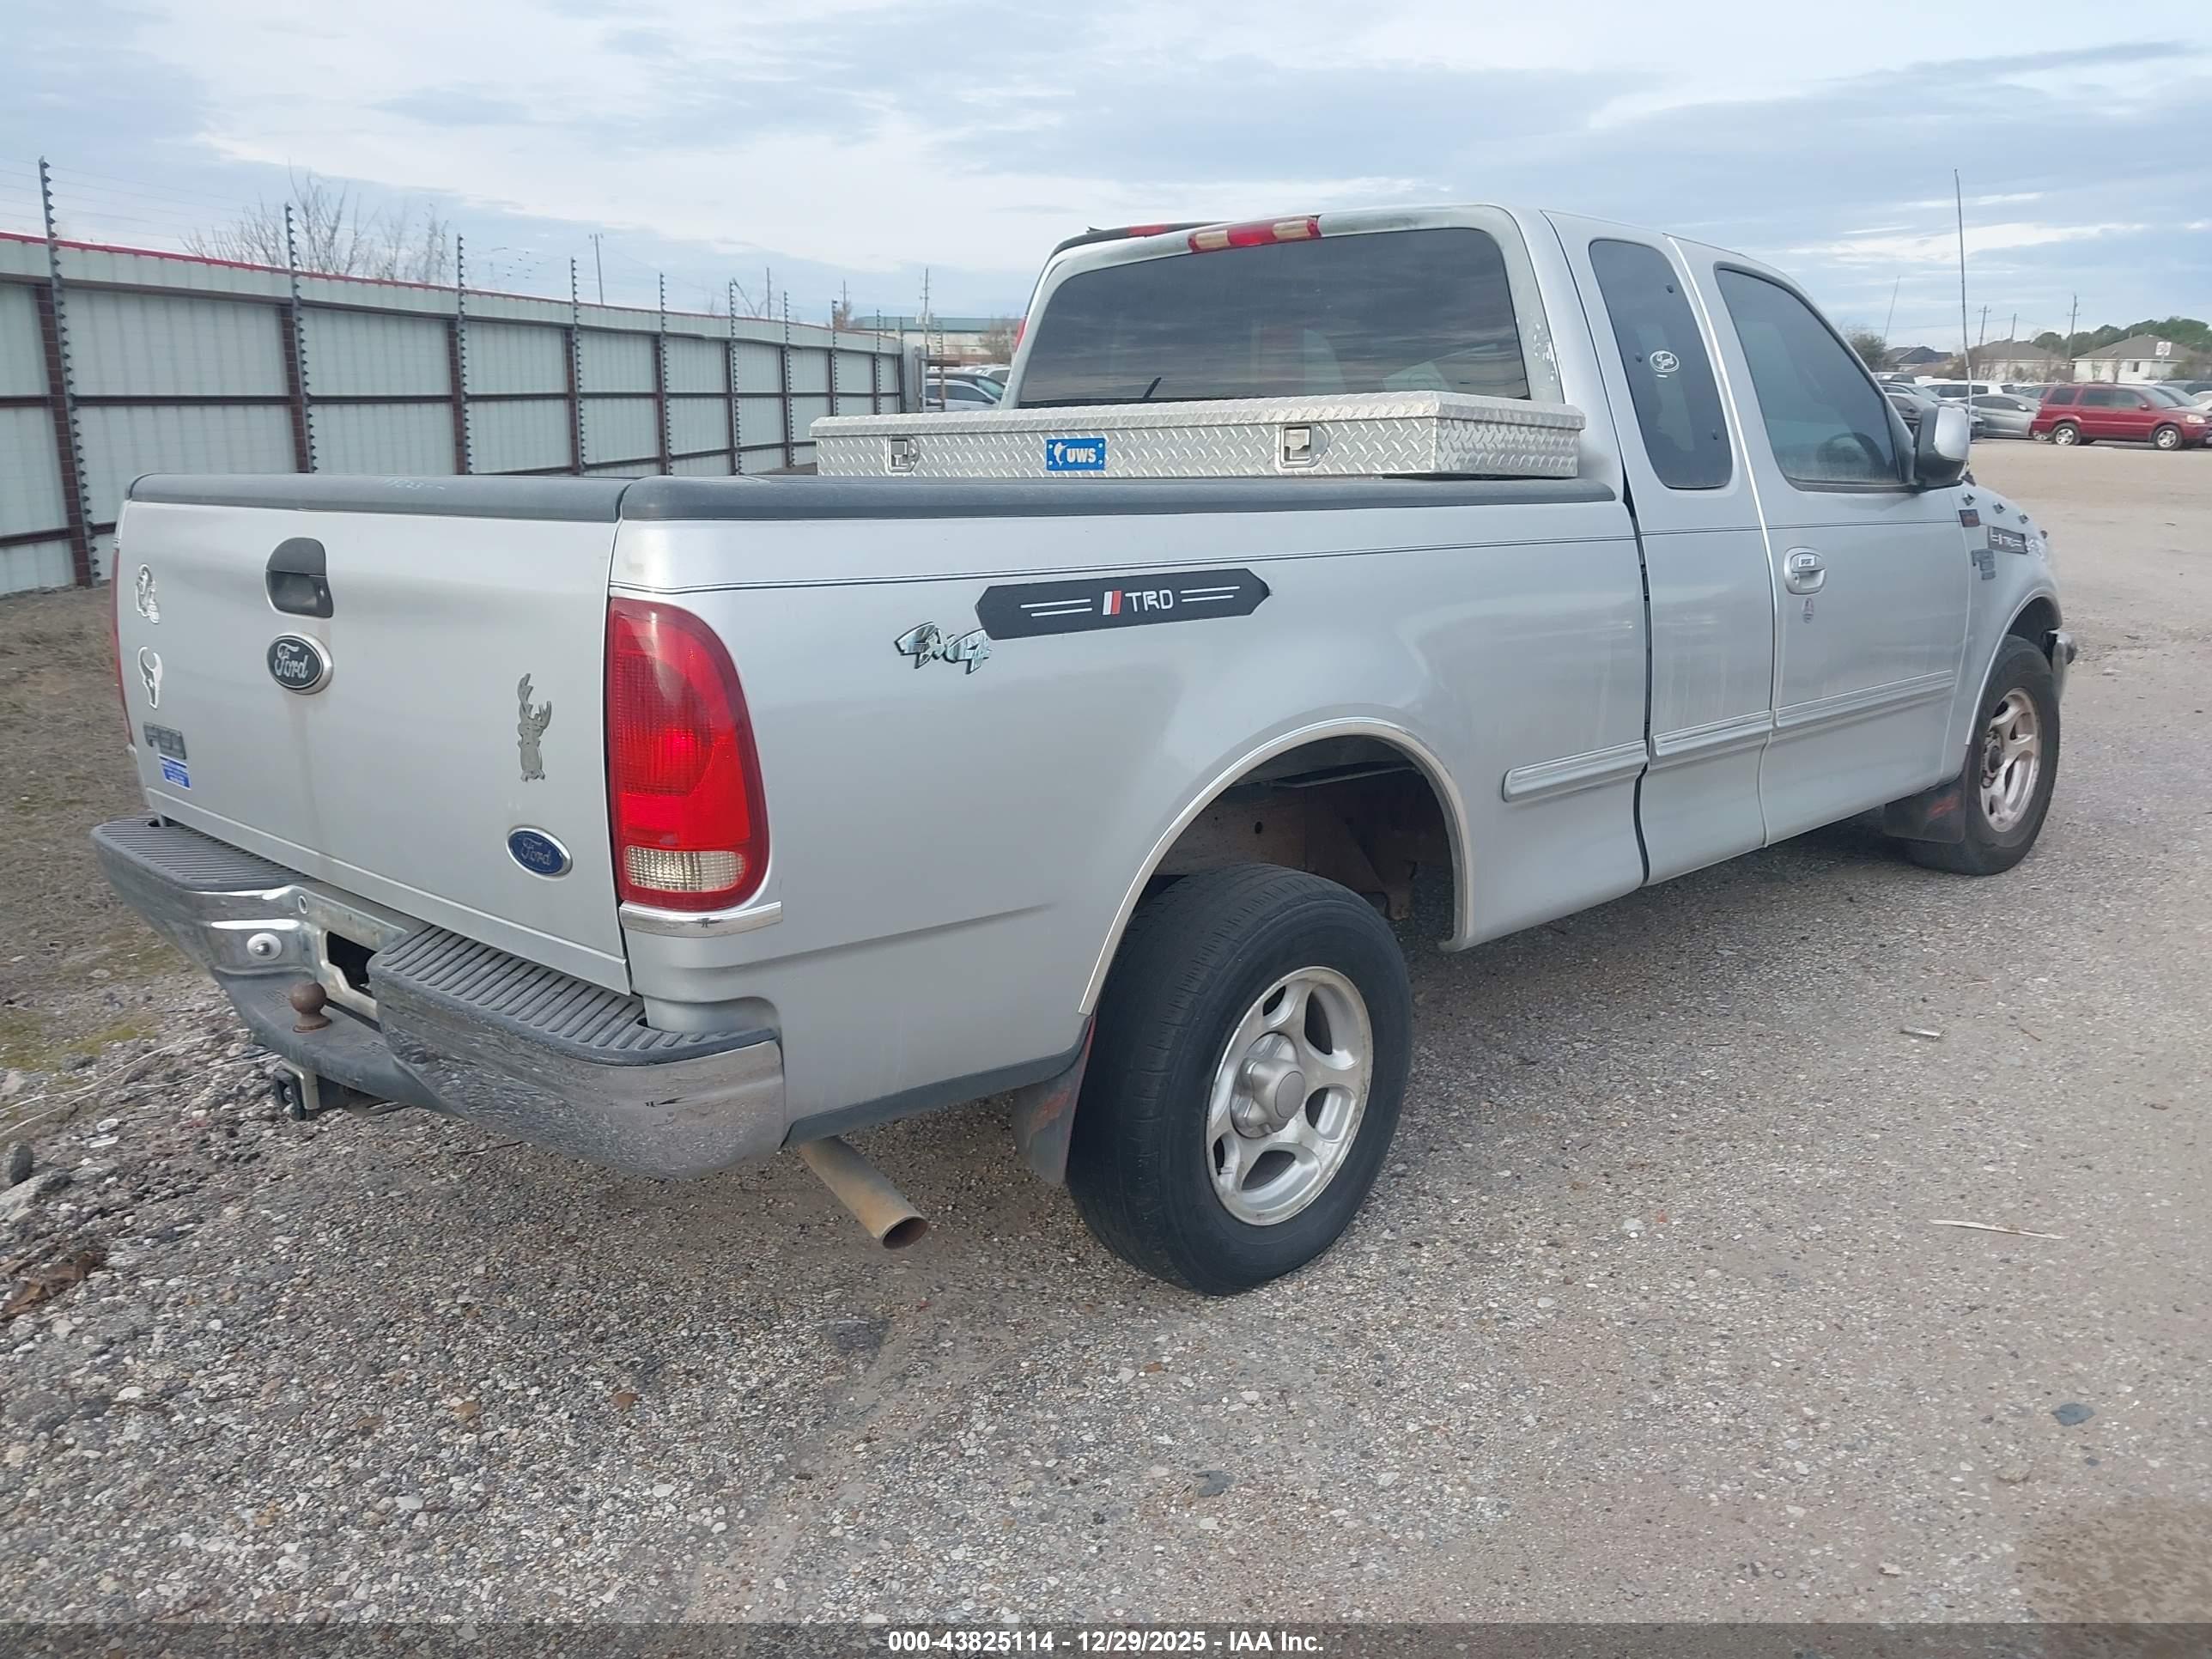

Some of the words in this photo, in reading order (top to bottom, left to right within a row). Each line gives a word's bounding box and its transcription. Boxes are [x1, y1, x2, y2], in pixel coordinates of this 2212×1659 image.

[1066, 447, 1097, 463] UWS
[1124, 589, 1174, 612] TRD
[274, 642, 309, 679] Ford
[520, 837, 552, 866] Ford
